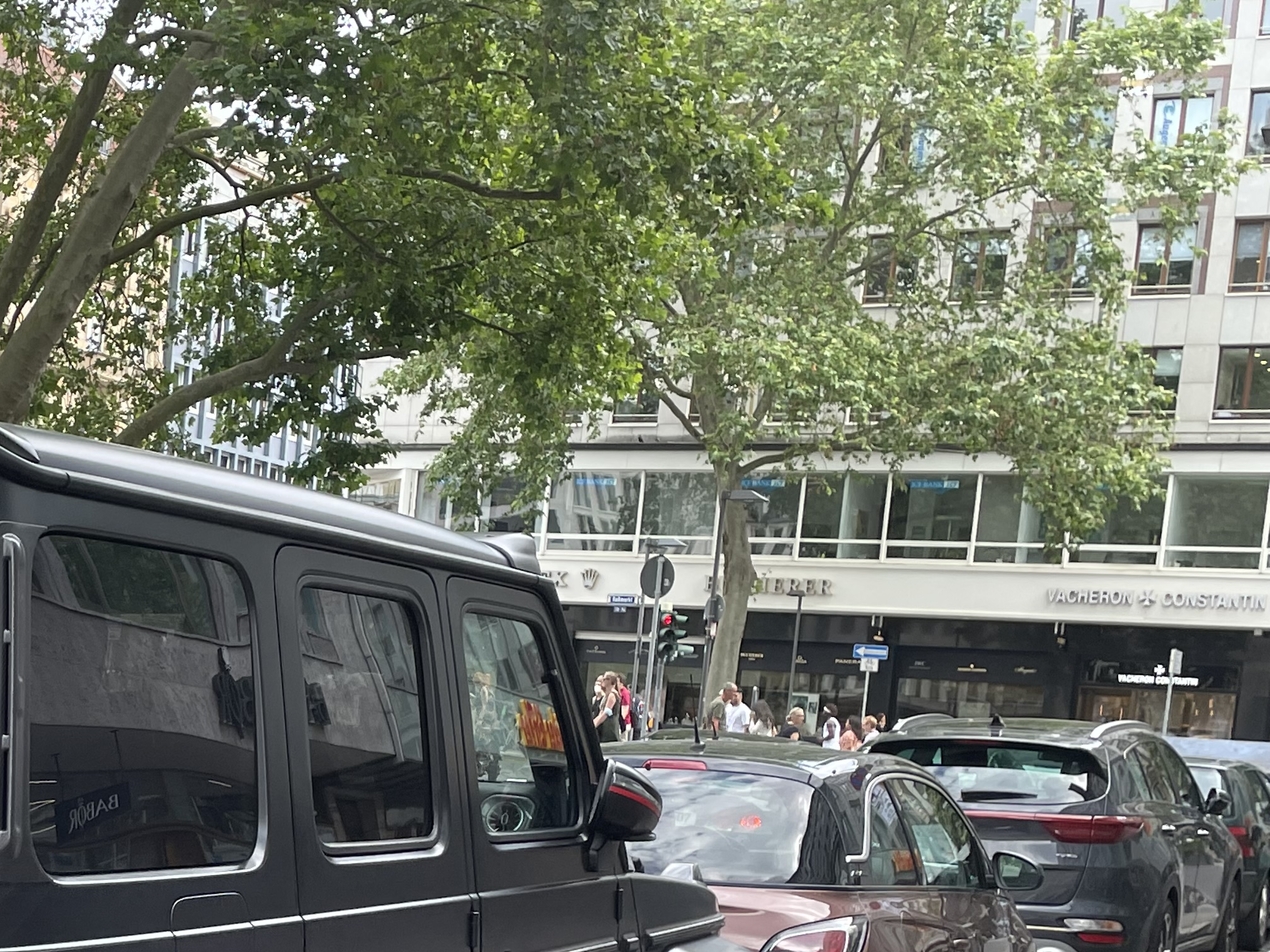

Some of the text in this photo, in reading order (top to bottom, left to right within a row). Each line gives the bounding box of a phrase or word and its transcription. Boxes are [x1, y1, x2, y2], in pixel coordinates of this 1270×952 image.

[1047, 588, 1267, 611] VACHERON CONSTANTIN
[1118, 674, 1154, 684] VACHERON
